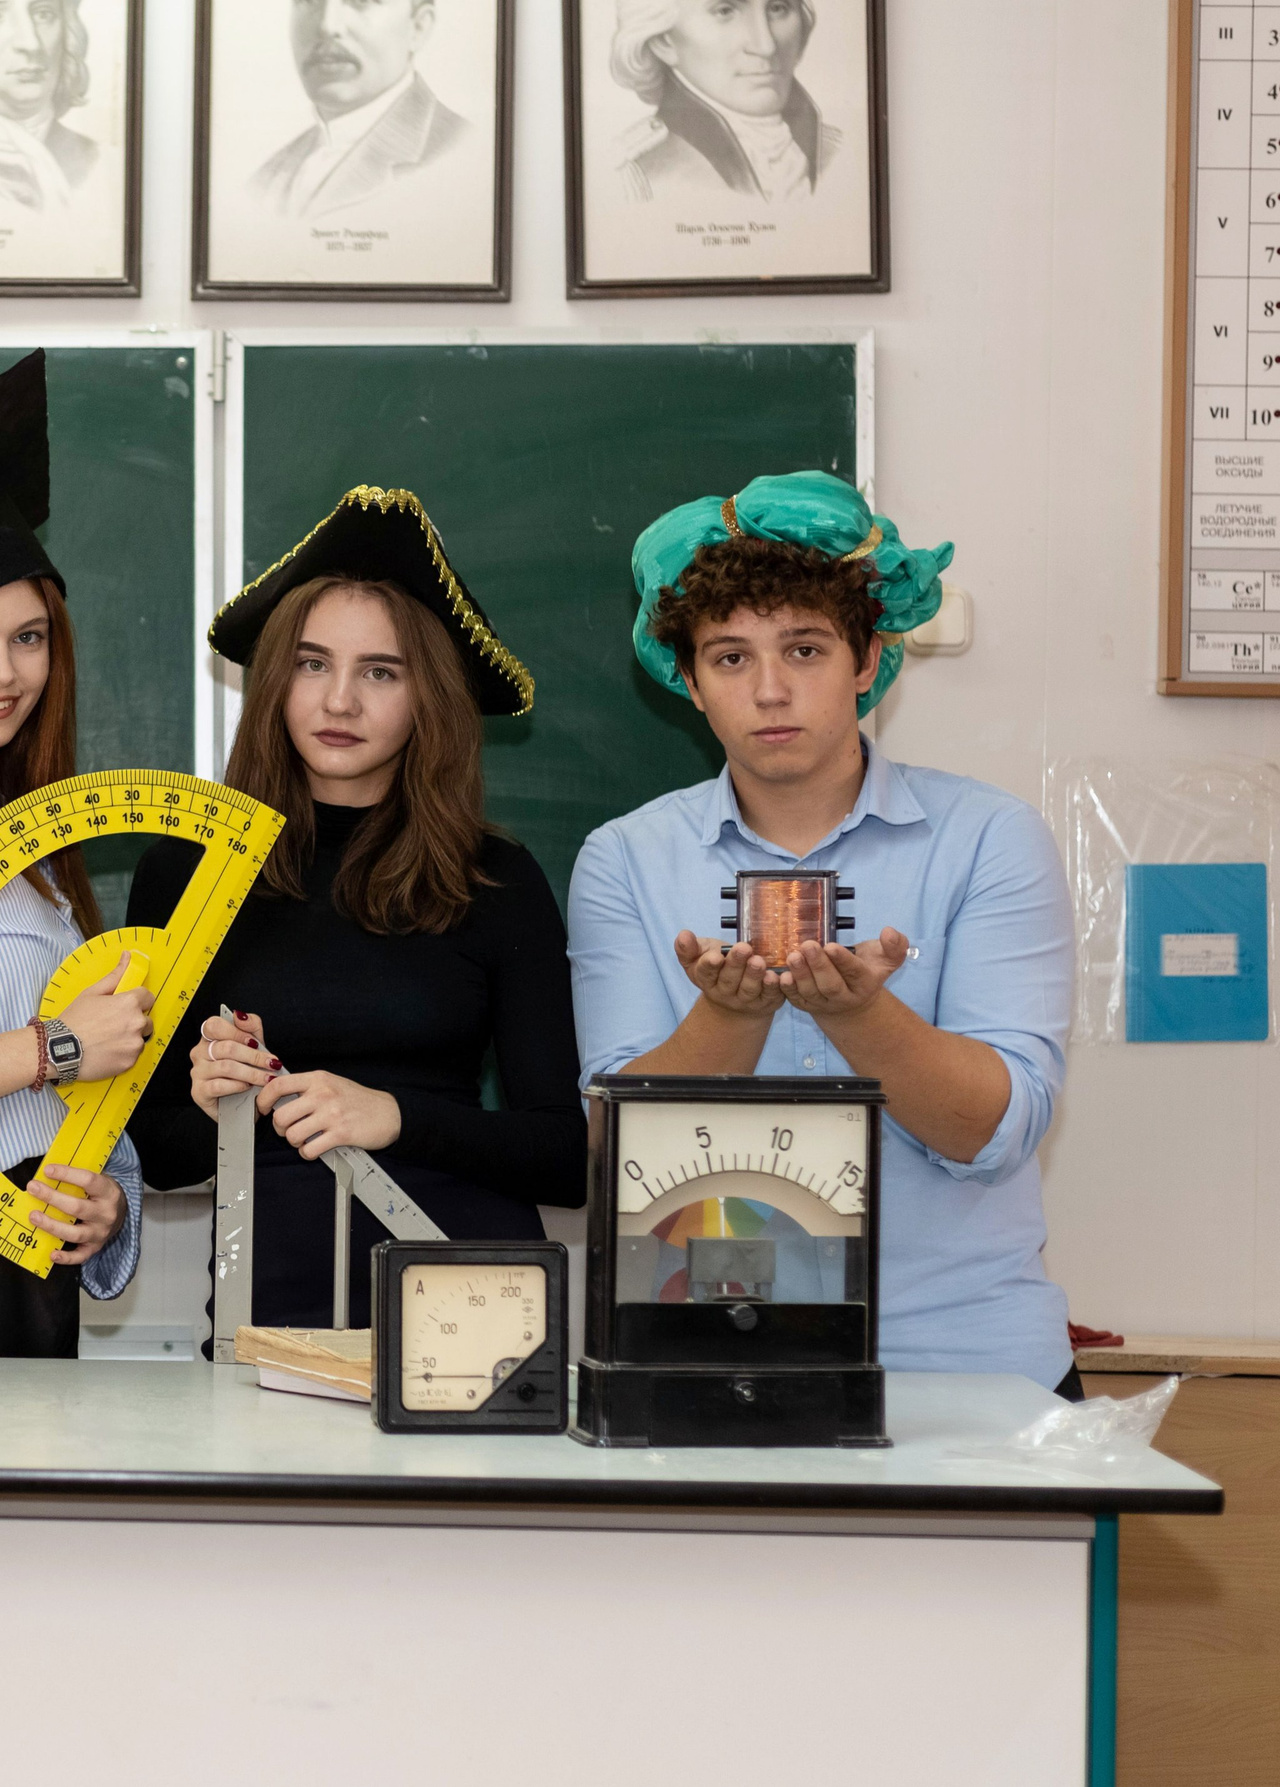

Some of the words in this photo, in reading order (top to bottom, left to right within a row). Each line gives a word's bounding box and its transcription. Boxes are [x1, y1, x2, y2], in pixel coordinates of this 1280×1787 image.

[1219, 27, 1233, 39] III
[1268, 30, 1279, 46] 3
[1267, 84, 1277, 100] 4
[1218, 109, 1232, 121] IV
[1266, 139, 1277, 154] 5
[1265, 192, 1276, 208] 6
[1217, 217, 1228, 229] V
[1265, 246, 1275, 263] 7
[1264, 301, 1274, 317] 8
[1213, 325, 1228, 337] VI
[1263, 355, 1273, 371] 9
[1209, 406, 1229, 419] VII
[1251, 409, 1271, 426] 10
[84, 793, 100, 805] 40
[124, 790, 140, 801] 30
[164, 792, 180, 805] 20
[46, 803, 61, 817] 50
[204, 803, 218, 816] 10
[86, 815, 107, 827] 140
[122, 812, 144, 824] 150
[159, 814, 180, 827] 160
[9, 820, 25, 835] 60
[51, 823, 72, 838] 130
[194, 824, 214, 839] 170
[243, 821, 251, 831] 0
[19, 838, 39, 855] 120
[228, 838, 247, 855] 180
[129, 1082, 138, 1093] 20
[178, 990, 187, 1001] 30
[227, 899, 235, 909] 40
[272, 812, 282, 823] 50
[695, 1126, 712, 1148] 5
[771, 1126, 794, 1151] 10
[624, 1160, 643, 1181] 0
[837, 1160, 863, 1187] 15
[0, 1192, 15, 1207] 10
[18, 1232, 38, 1249] 180
[415, 1280, 425, 1295] A
[500, 1286, 521, 1298] 200
[468, 1295, 486, 1307] 150
[440, 1323, 458, 1335] 100
[422, 1357, 436, 1369] 50
